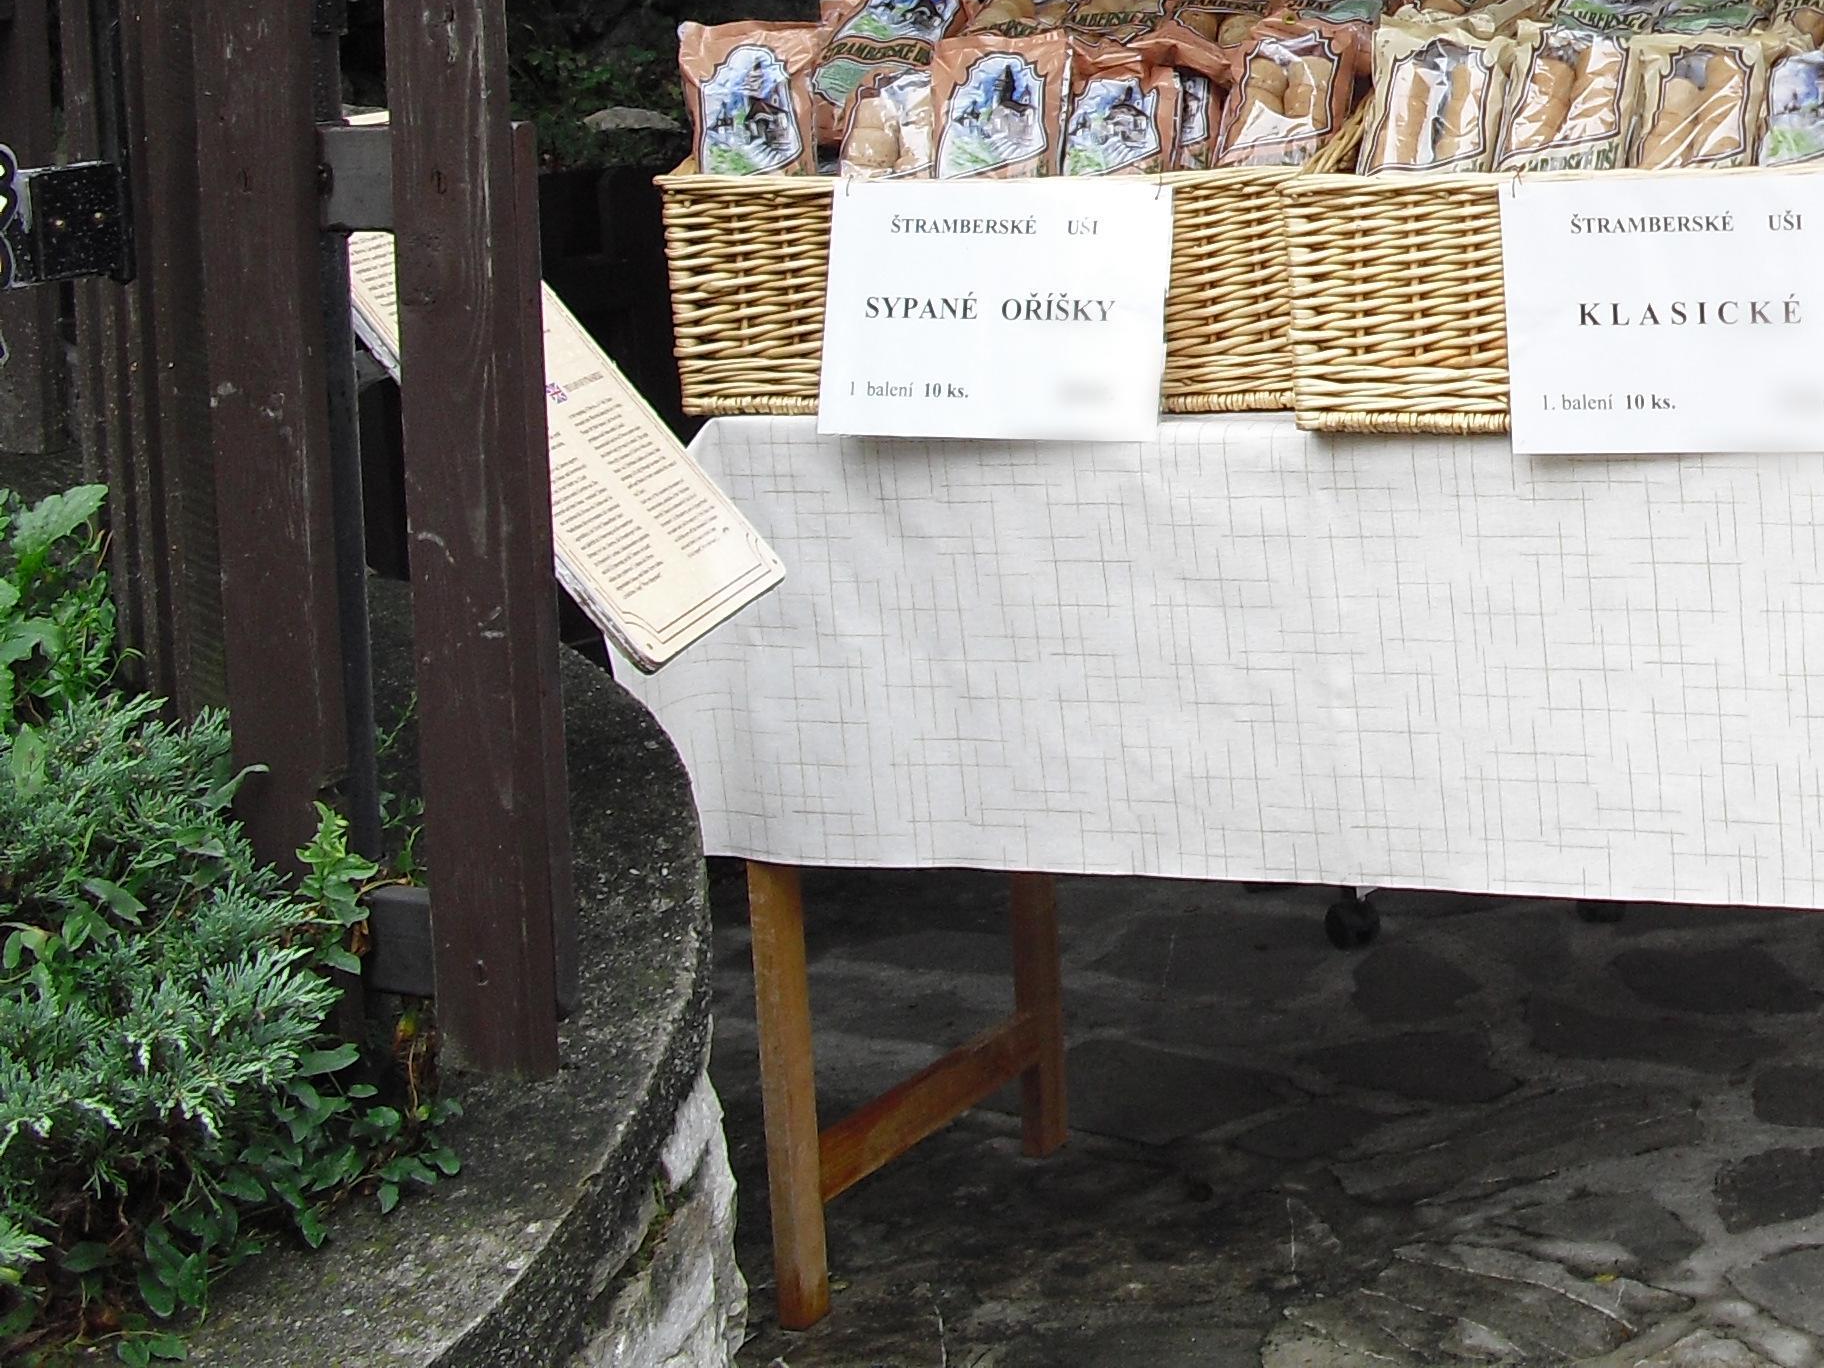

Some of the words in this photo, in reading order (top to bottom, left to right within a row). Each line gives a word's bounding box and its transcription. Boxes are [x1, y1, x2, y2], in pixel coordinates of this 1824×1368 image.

[890, 213, 1037, 235] ŠTRAMBERSKÉ
[1067, 216, 1101, 236] UŠI
[1570, 209, 1734, 234] ŠTRAMBERSKÉ
[1768, 210, 1803, 232] UŠI
[864, 291, 979, 321] SYPANÉ
[1001, 292, 1116, 322] OŘÍŠKY
[866, 380, 914, 398] balení
[924, 382, 942, 399] 10
[947, 381, 970, 399] ks.
[1541, 394, 1557, 411] 1.
[1562, 392, 1613, 411] balení
[1625, 394, 1645, 411] 10
[1651, 393, 1677, 411] ks.
